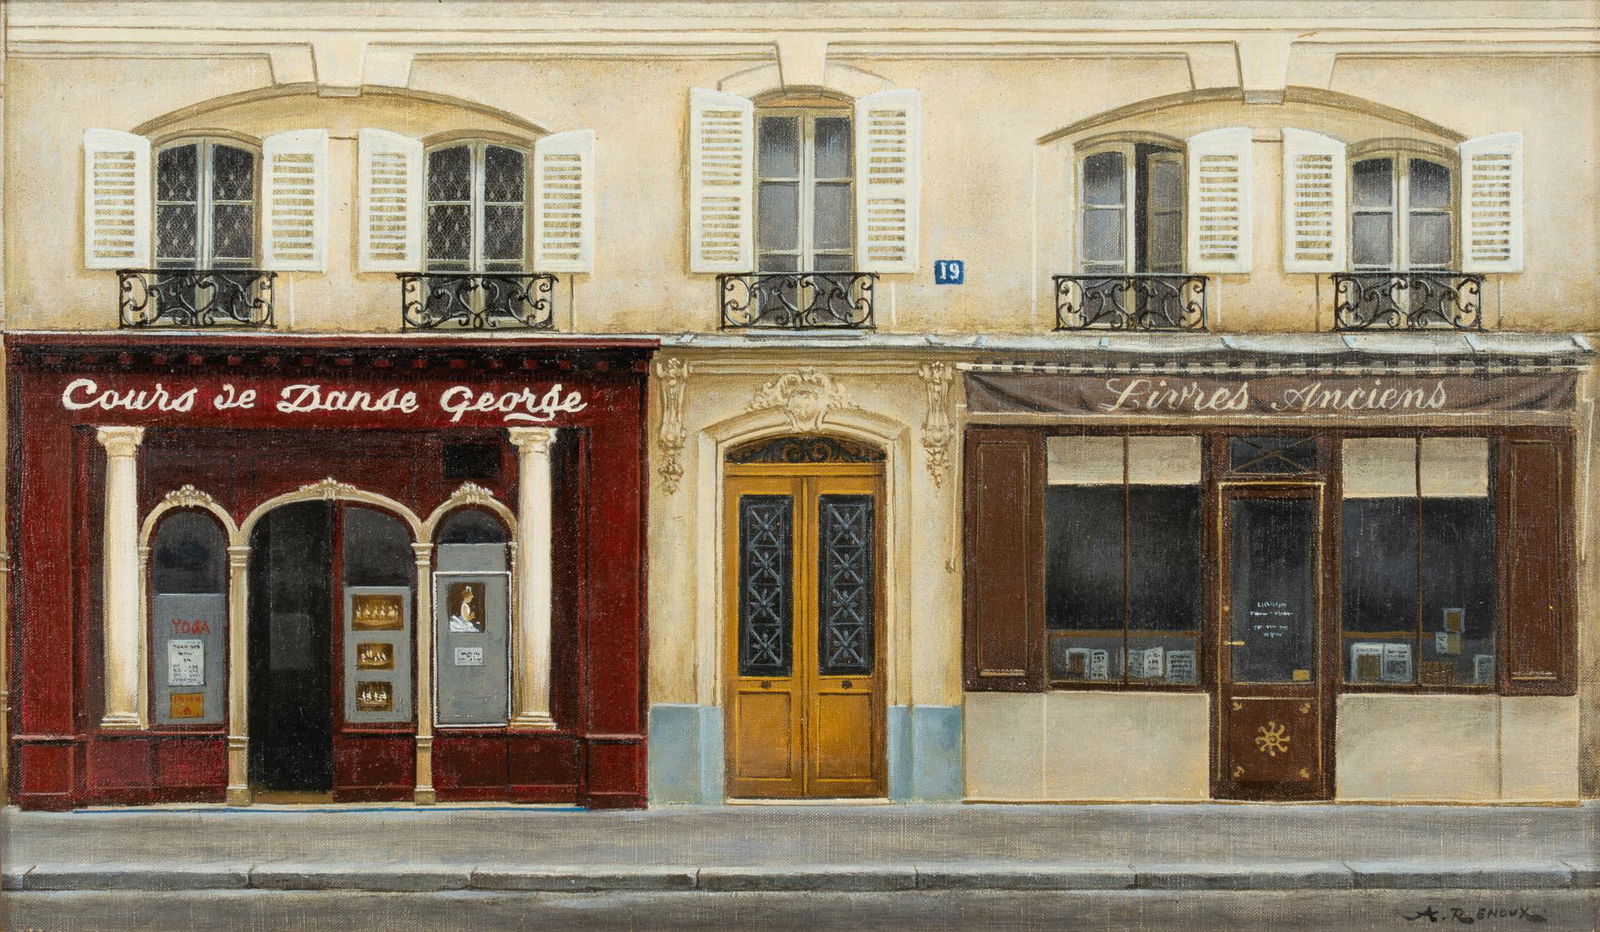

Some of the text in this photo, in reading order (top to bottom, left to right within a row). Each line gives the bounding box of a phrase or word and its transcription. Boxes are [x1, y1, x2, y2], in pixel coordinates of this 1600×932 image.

[940, 262, 960, 280] 19
[62, 379, 587, 422] Cours de Danse George
[1100, 379, 1446, 411] Livres Anciens
[171, 618, 211, 635] YOGA
